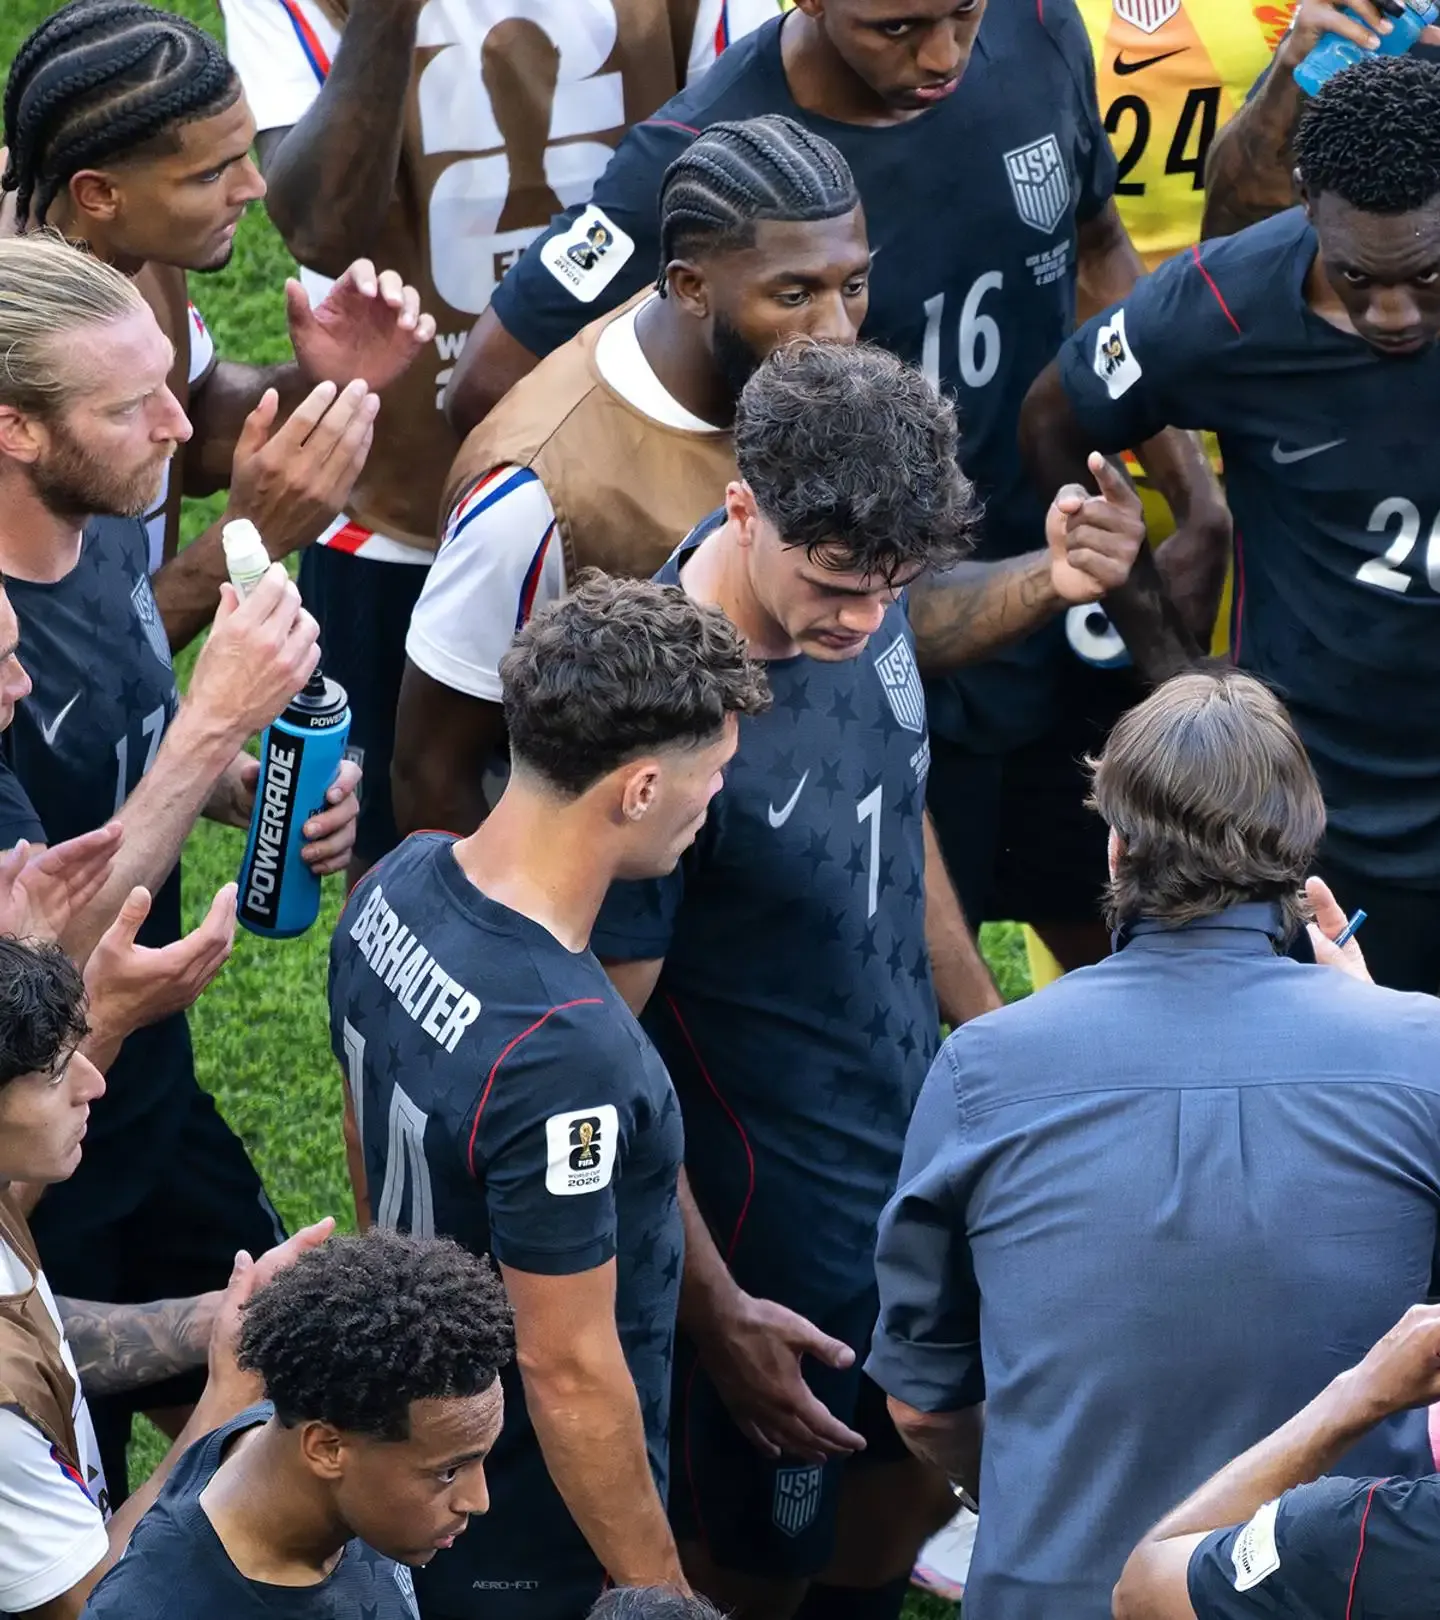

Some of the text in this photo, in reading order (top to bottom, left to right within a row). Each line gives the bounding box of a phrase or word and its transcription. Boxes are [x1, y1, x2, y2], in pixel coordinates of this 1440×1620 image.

[1009, 140, 1058, 184] USA
[1104, 86, 1222, 196] 24
[921, 269, 1004, 400] 16
[879, 640, 911, 686] USA
[246, 743, 297, 915] POWERADE
[349, 884, 482, 1054] BERHALTER
[567, 1176, 600, 1188] 2026
[780, 1468, 820, 1499] USA
